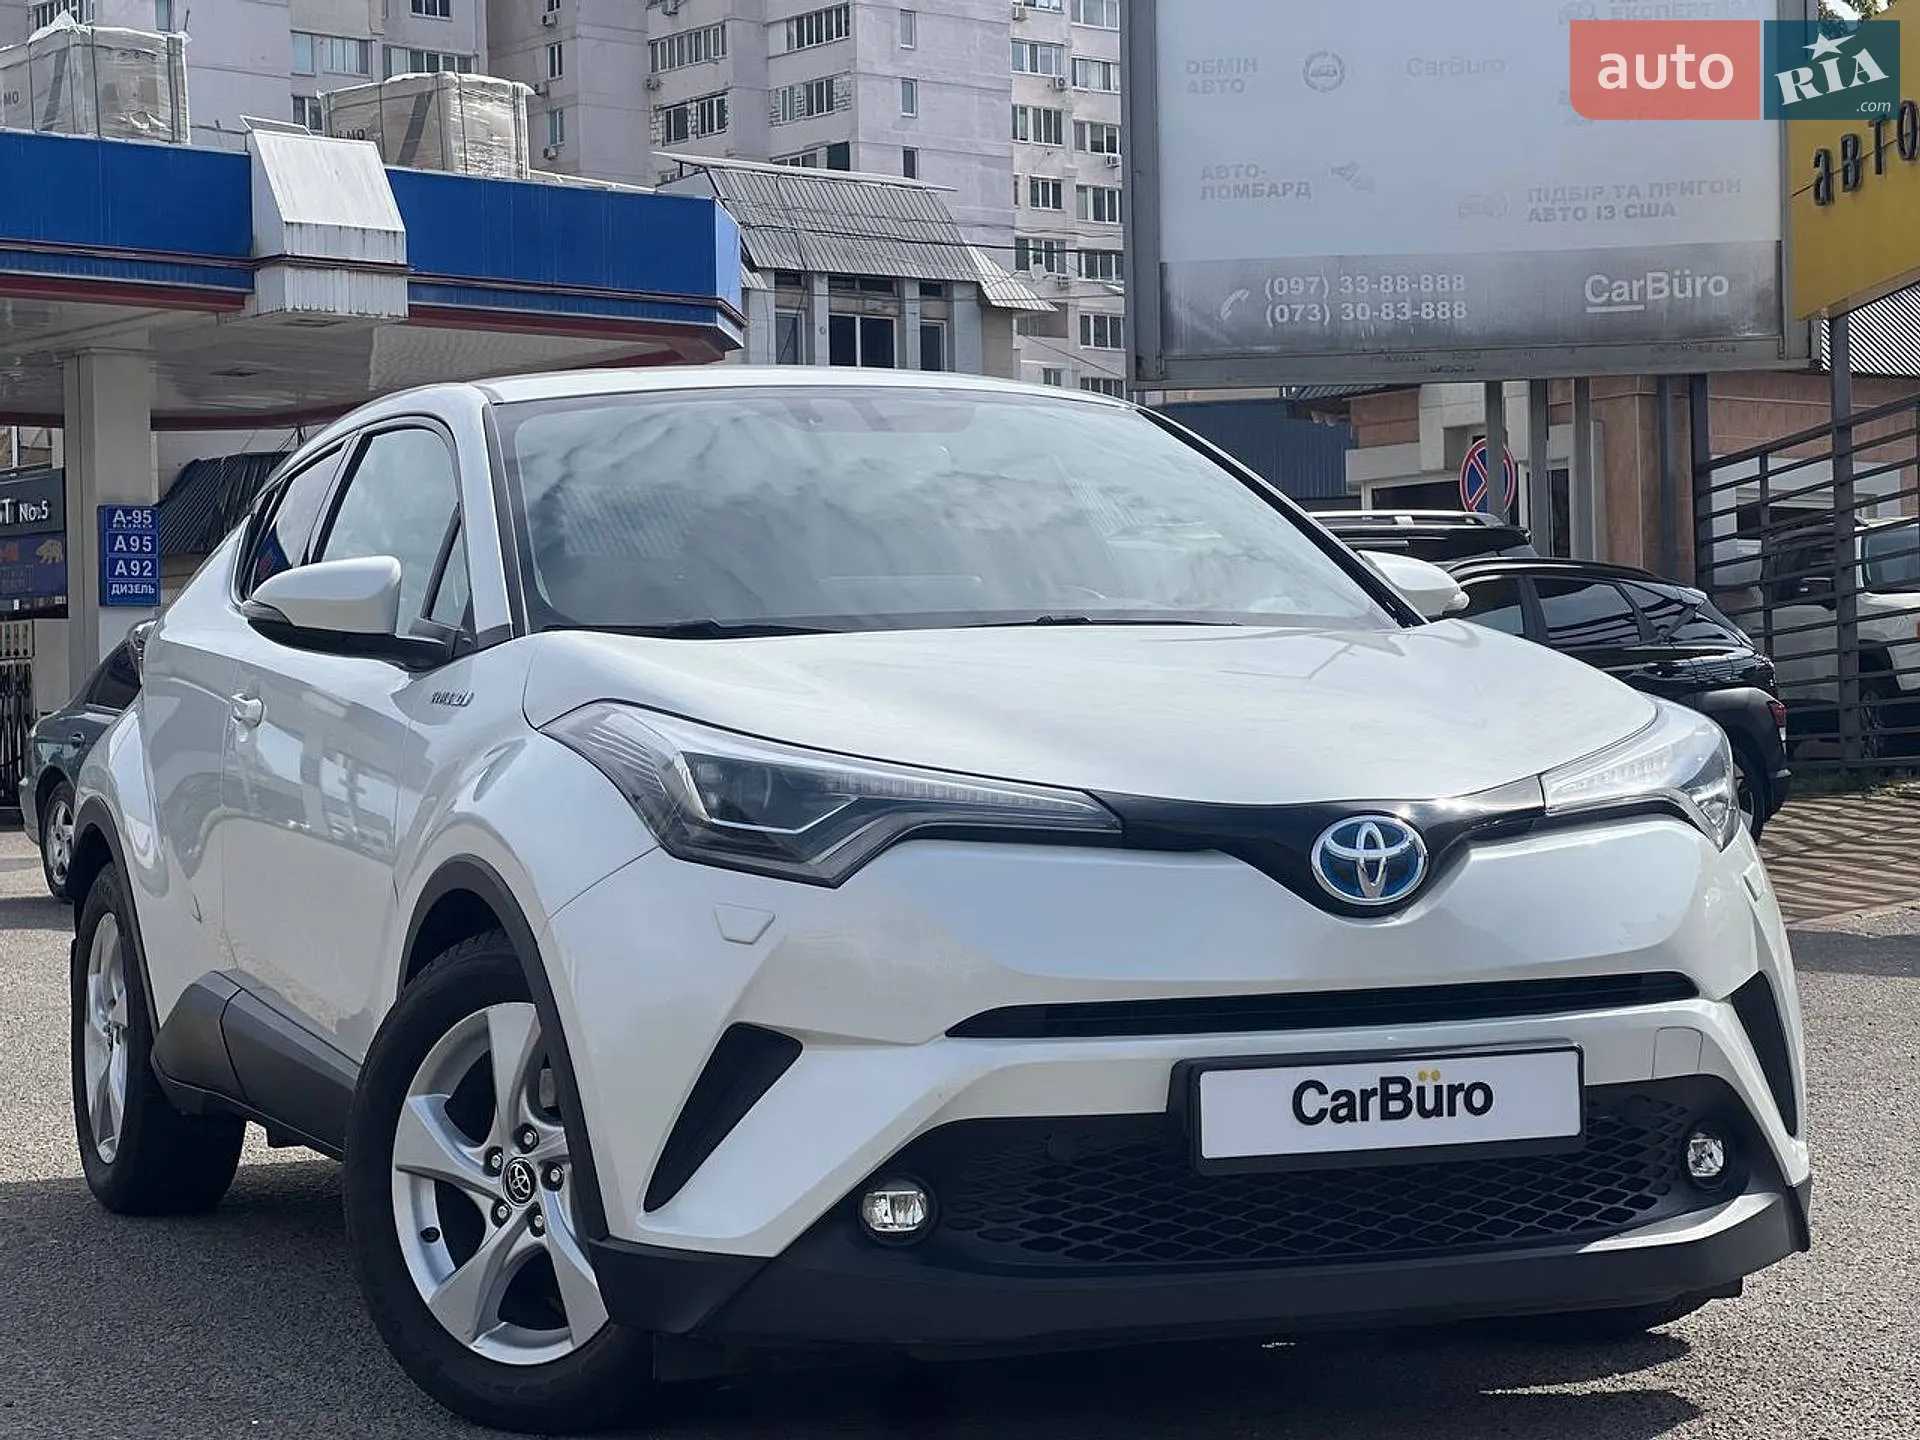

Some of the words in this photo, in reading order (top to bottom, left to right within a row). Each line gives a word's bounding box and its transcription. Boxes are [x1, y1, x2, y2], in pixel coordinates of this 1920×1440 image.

[1186, 78, 1245, 95] АВТО
[1200, 181, 1312, 200] ЛОМБАРД
[1527, 184, 1603, 205] ПІДБІР
[1610, 183, 1641, 200] ТА
[1647, 178, 1742, 198] ПРИГОН
[1527, 205, 1588, 223] АВТО
[1623, 202, 1677, 219] США
[1264, 276, 1330, 300] (097)
[1338, 274, 1466, 294] 33-88-888
[1584, 269, 1729, 304] CarBüro
[1265, 302, 1331, 327] (073)
[1340, 301, 1468, 321] 30-83-888
[111, 583, 156, 595] ДИЗЕЛЬ
[1292, 1069, 1494, 1126] CarBüro
